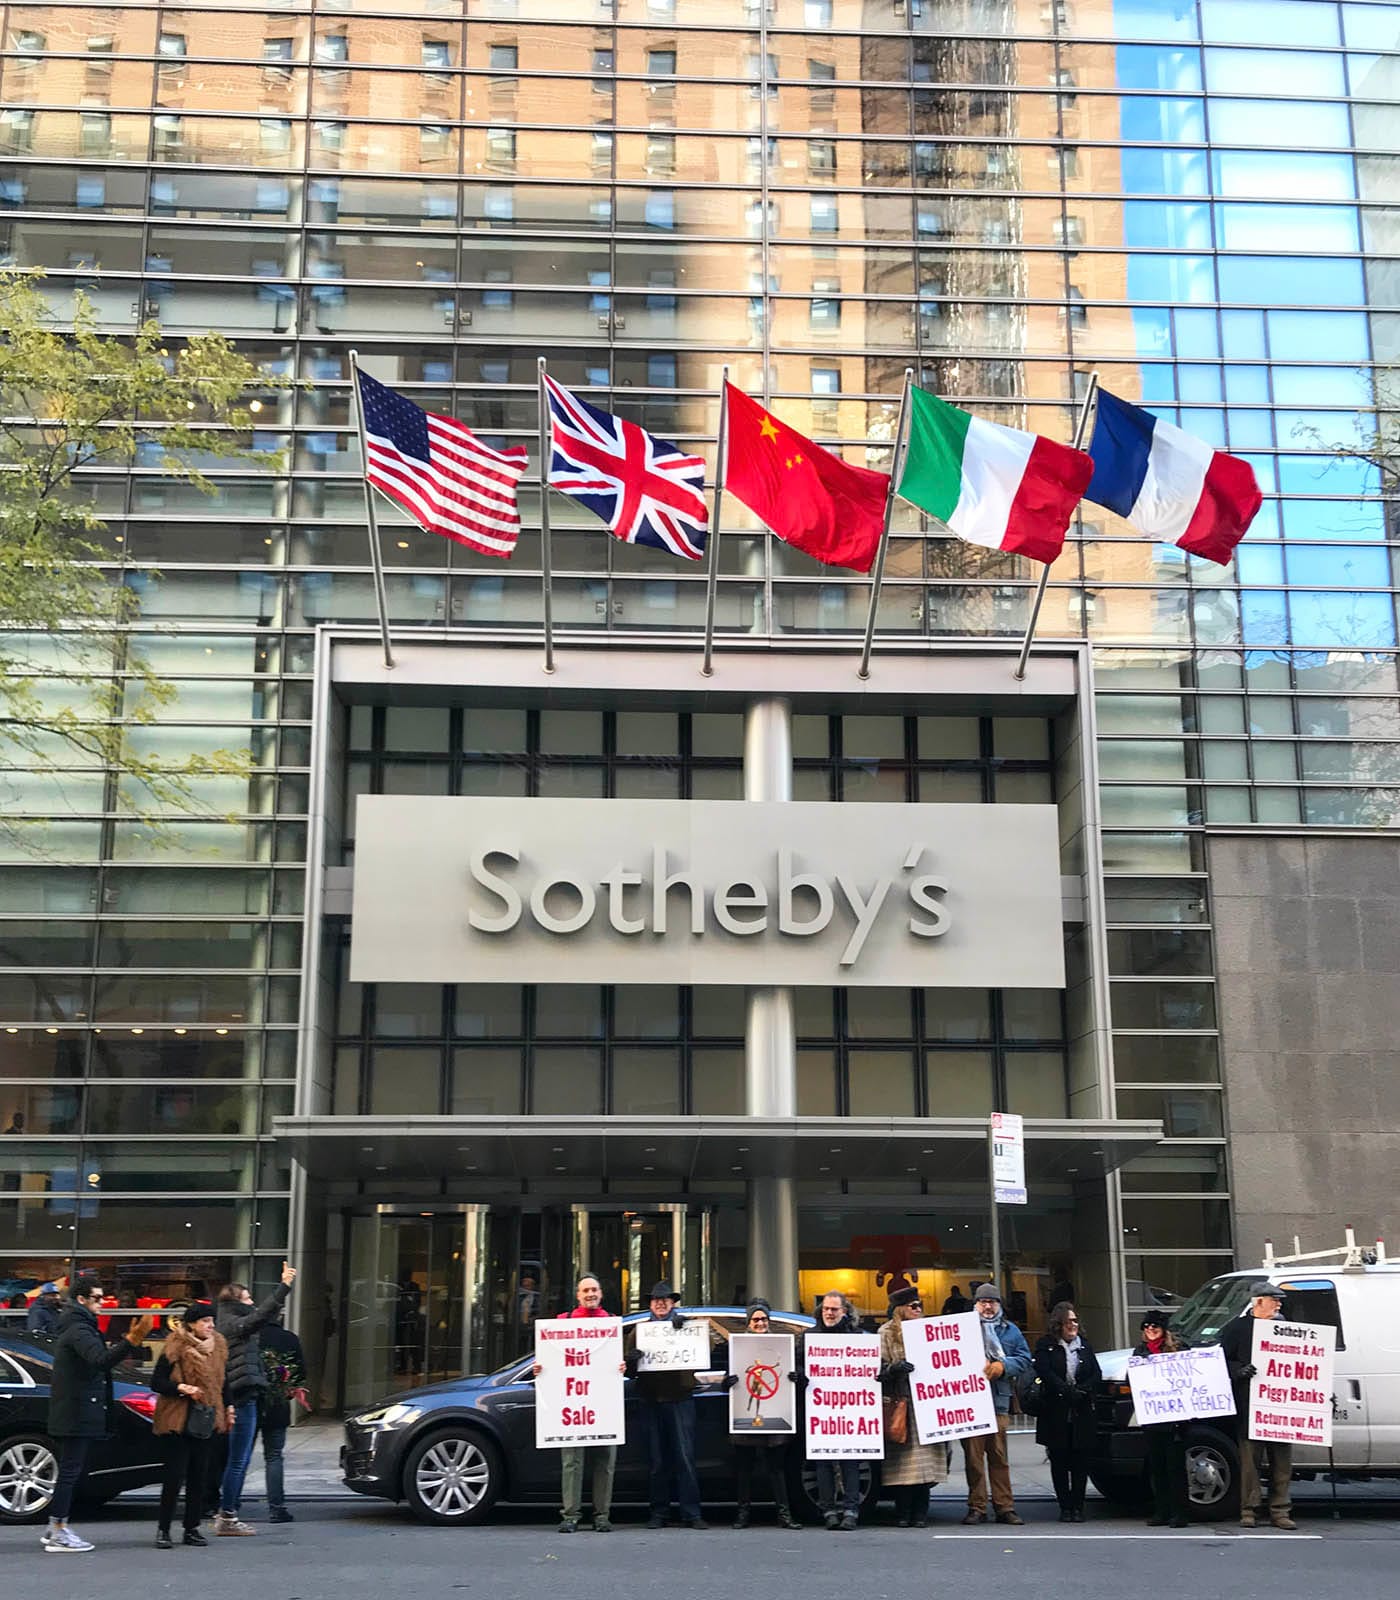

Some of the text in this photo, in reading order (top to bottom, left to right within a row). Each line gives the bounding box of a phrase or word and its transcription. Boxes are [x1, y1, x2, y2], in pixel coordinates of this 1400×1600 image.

[467, 846, 952, 966] Sotheby's
[540, 1325, 618, 1340] Norman Rockwell
[644, 1326, 657, 1337] WE
[924, 1321, 961, 1343] Bring
[565, 1347, 590, 1367] Not
[808, 1345, 879, 1359] Attorney General
[1260, 1340, 1325, 1357] Museums & Art
[931, 1348, 962, 1370] OUR
[1153, 1358, 1204, 1378] THANK
[1266, 1358, 1319, 1380] Are Not
[809, 1364, 878, 1380] Maura Healey
[566, 1377, 590, 1396] For
[915, 1373, 986, 1401] Rockwells
[1166, 1377, 1192, 1389] YOU
[1192, 1384, 1208, 1397] AG
[812, 1387, 875, 1410] Supports
[1143, 1397, 1186, 1415] MAURA
[1191, 1392, 1233, 1412] HEALEY
[1259, 1383, 1325, 1404] Piggy Banks
[562, 1405, 595, 1426] Sale
[809, 1415, 880, 1435] Public Art
[936, 1406, 975, 1427] Home
[1255, 1410, 1324, 1430] Return our Art
[1263, 1428, 1295, 1440] Berkshire
[1296, 1431, 1324, 1443] Museum
